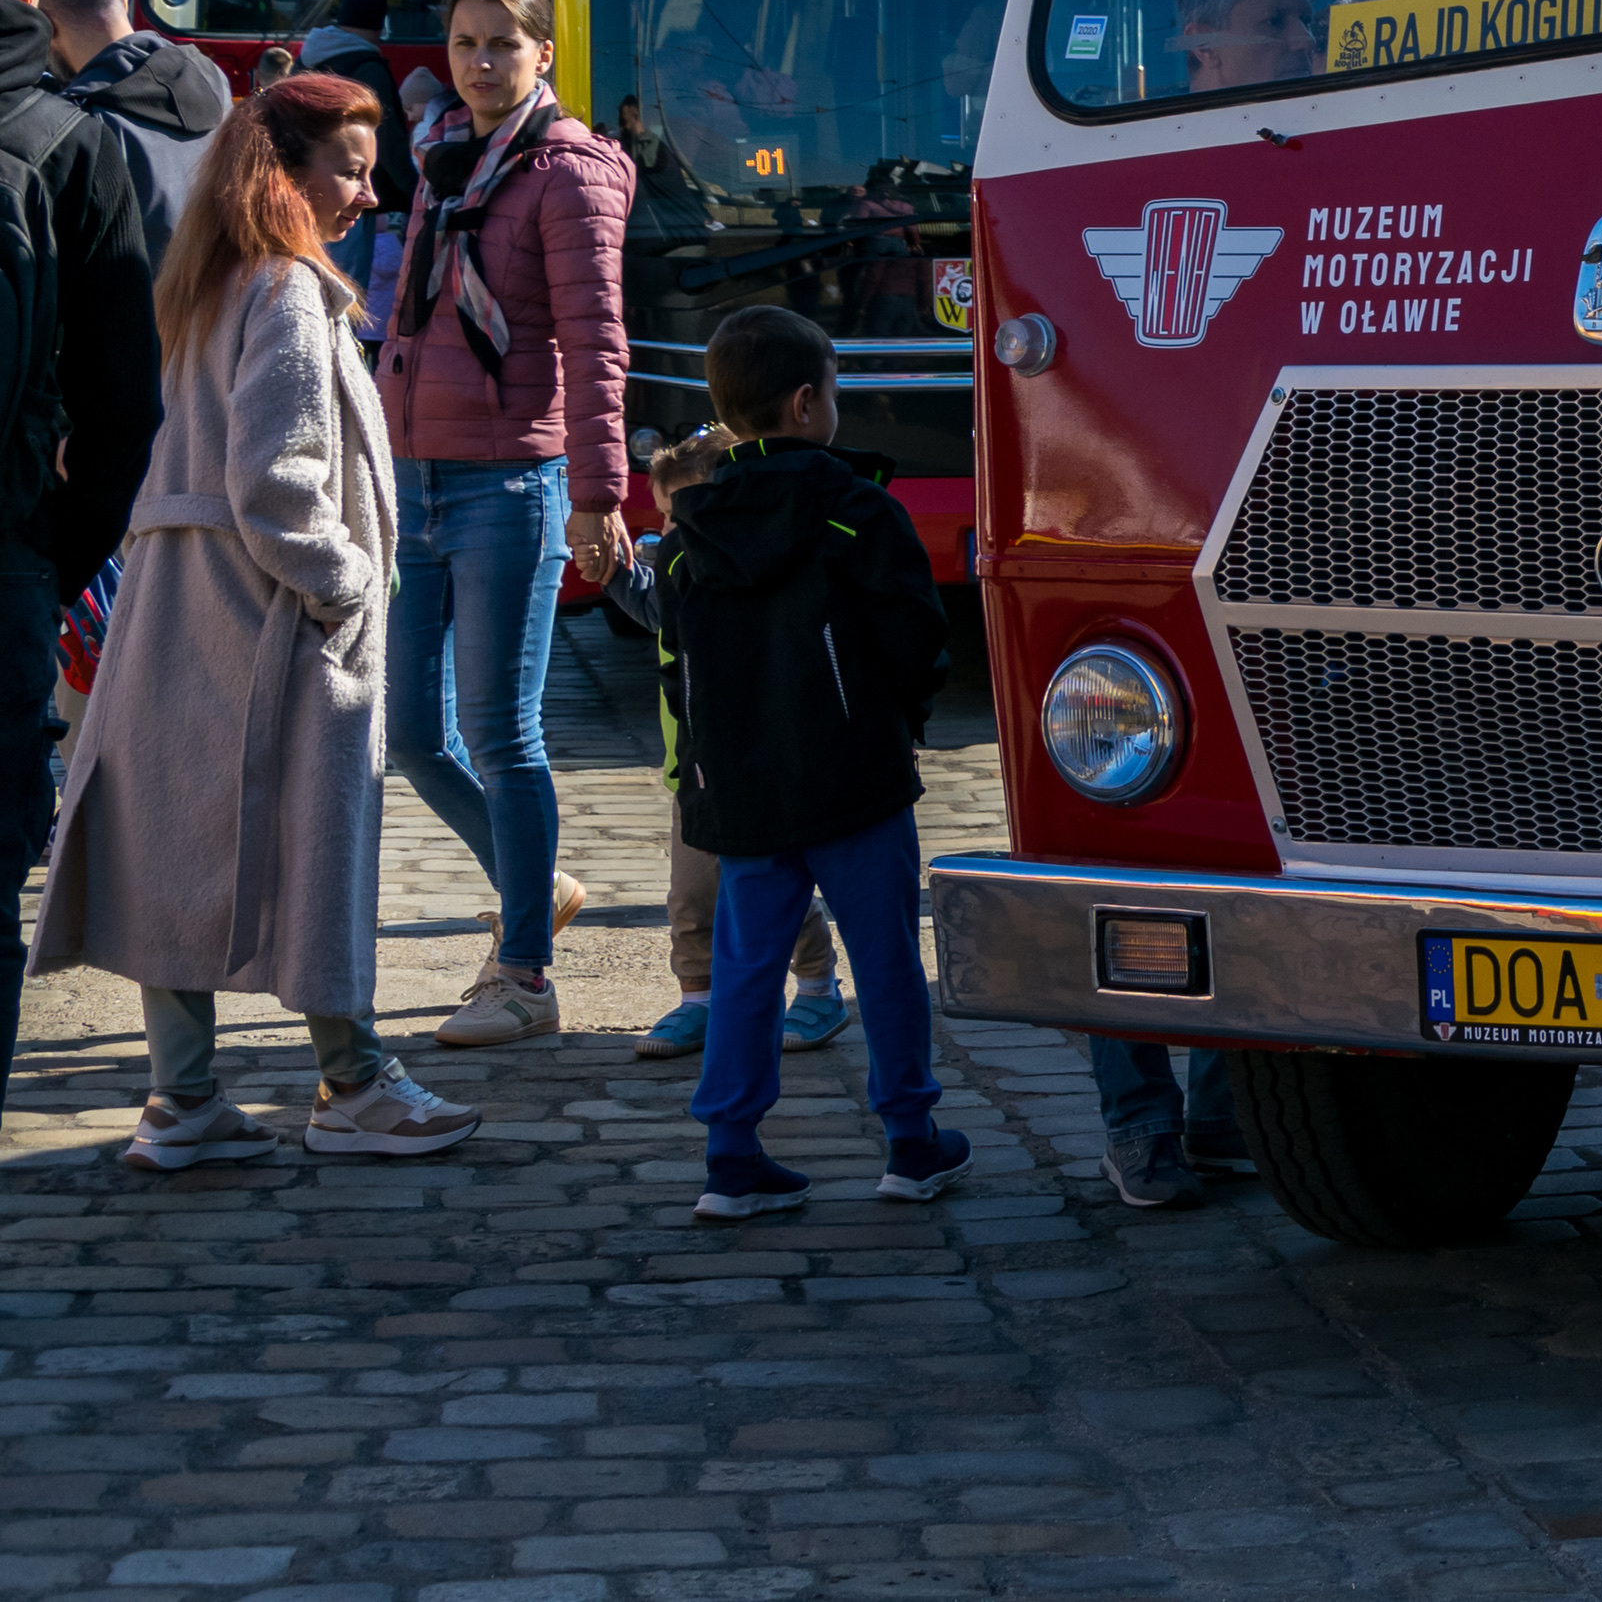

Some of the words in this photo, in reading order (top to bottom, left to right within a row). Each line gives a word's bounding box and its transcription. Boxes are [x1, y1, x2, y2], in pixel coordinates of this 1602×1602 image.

[1077, 26, 1099, 35] 2020
[1373, 6, 1469, 67] RAJD
[745, 147, 785, 176] -01
[1307, 204, 1443, 241] MUZEUM
[1302, 249, 1533, 288] MOTORYZACJI
[1300, 301, 1325, 334] W
[1339, 298, 1462, 334] OŁAWIE
[1431, 989, 1452, 1009] PL
[1464, 945, 1588, 1021] DOA
[1463, 1025, 1520, 1042] MUZEUM
